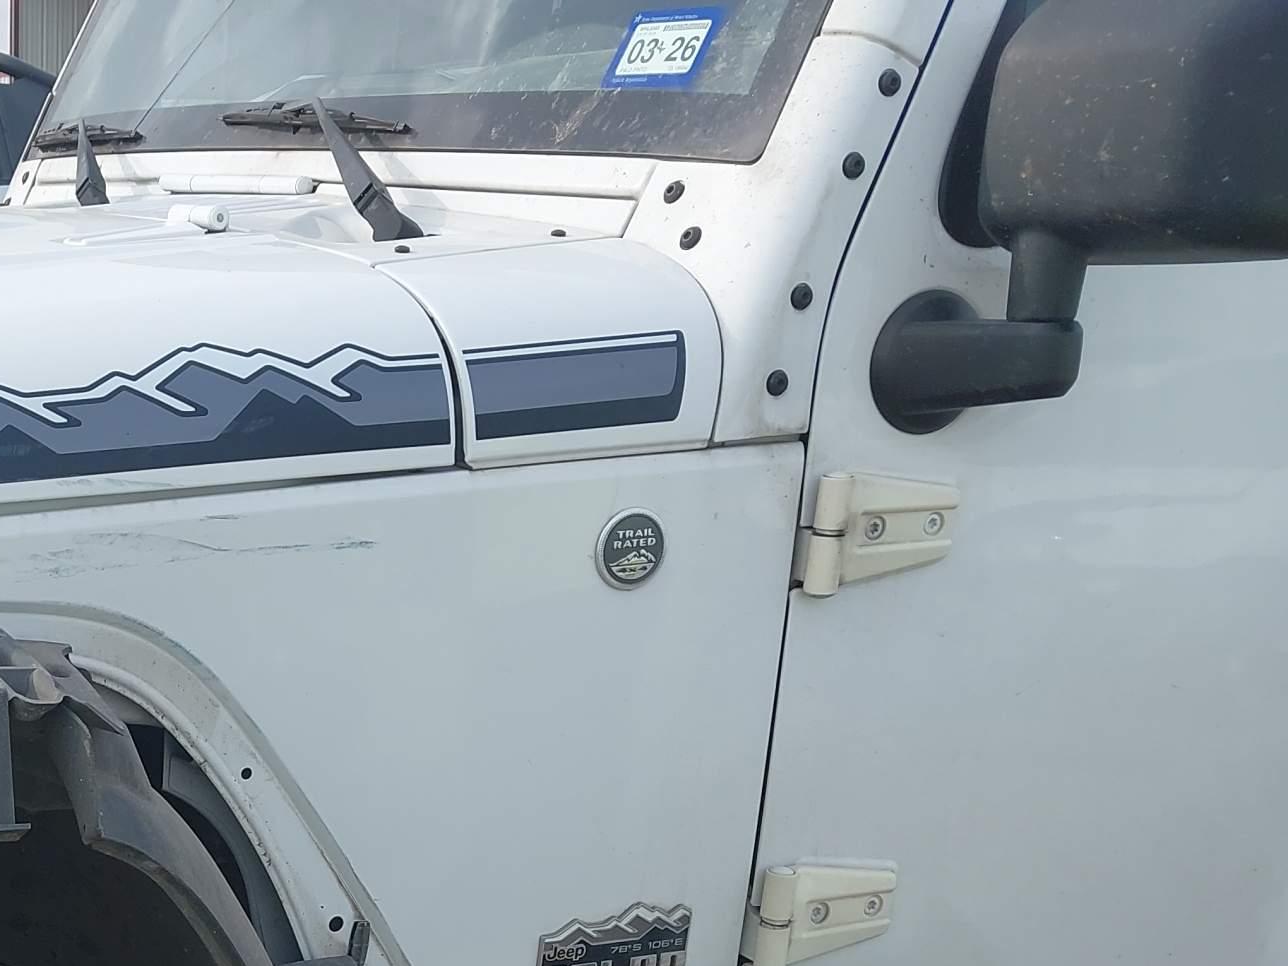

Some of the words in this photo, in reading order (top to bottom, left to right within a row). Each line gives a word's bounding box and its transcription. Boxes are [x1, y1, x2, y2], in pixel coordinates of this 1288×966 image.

[627, 38, 660, 65] 03
[664, 36, 700, 62] 26
[617, 528, 655, 539] TRAIL
[614, 538, 656, 549] RATED
[546, 944, 586, 962] Jeep
